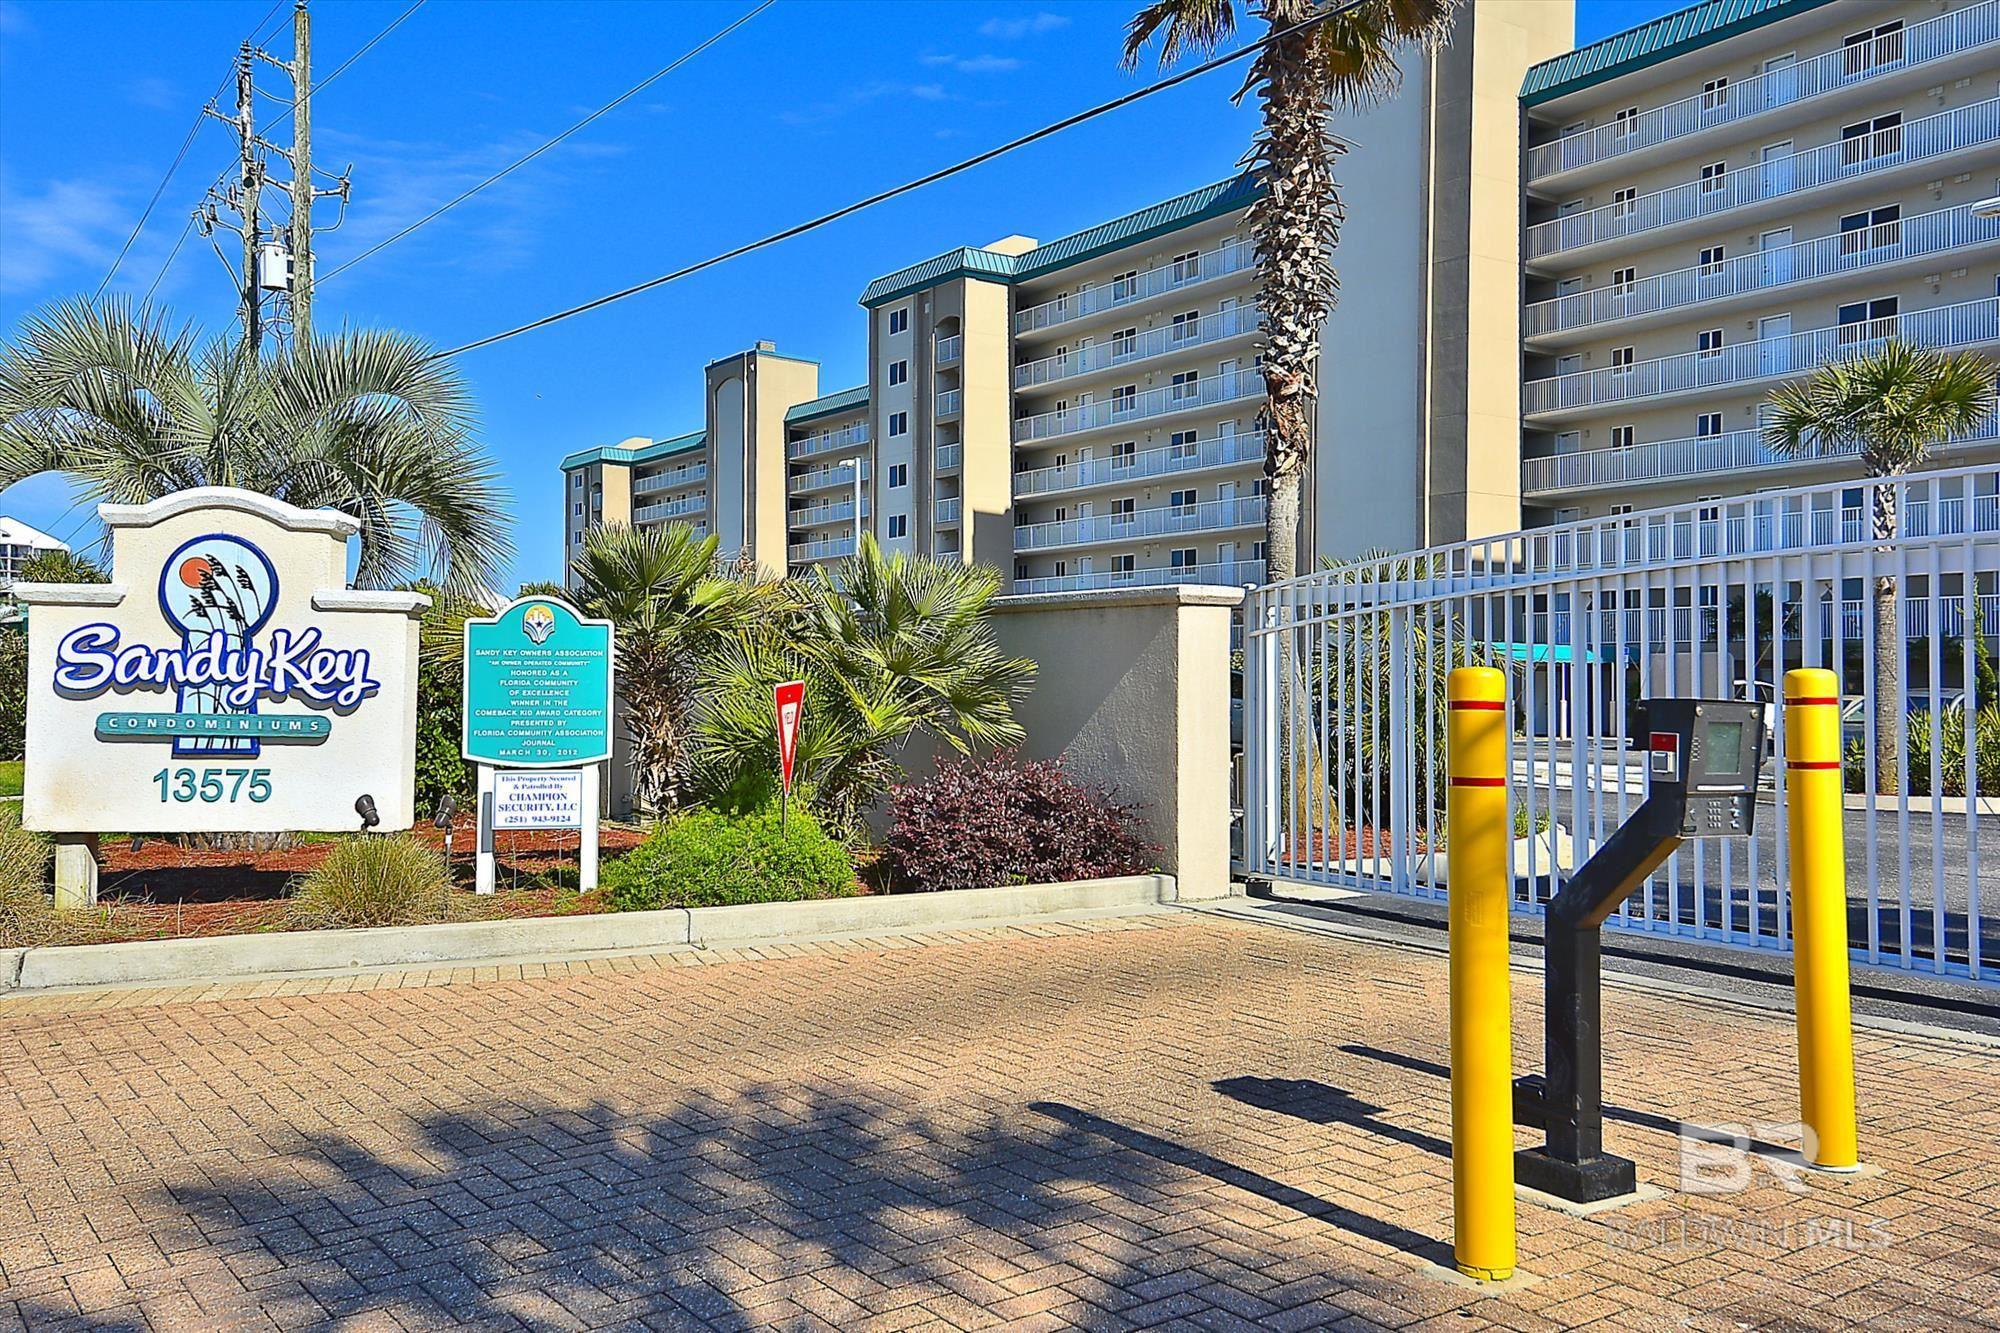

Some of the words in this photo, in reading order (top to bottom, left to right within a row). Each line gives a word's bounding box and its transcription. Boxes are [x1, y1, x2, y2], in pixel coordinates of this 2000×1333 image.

[54, 623, 271, 710] Sandy
[269, 627, 380, 705] Key
[109, 718, 319, 731] CONDOMINIUMS
[153, 768, 272, 802] 13575
[557, 803, 577, 811] LLC
[505, 816, 528, 824] (251)
